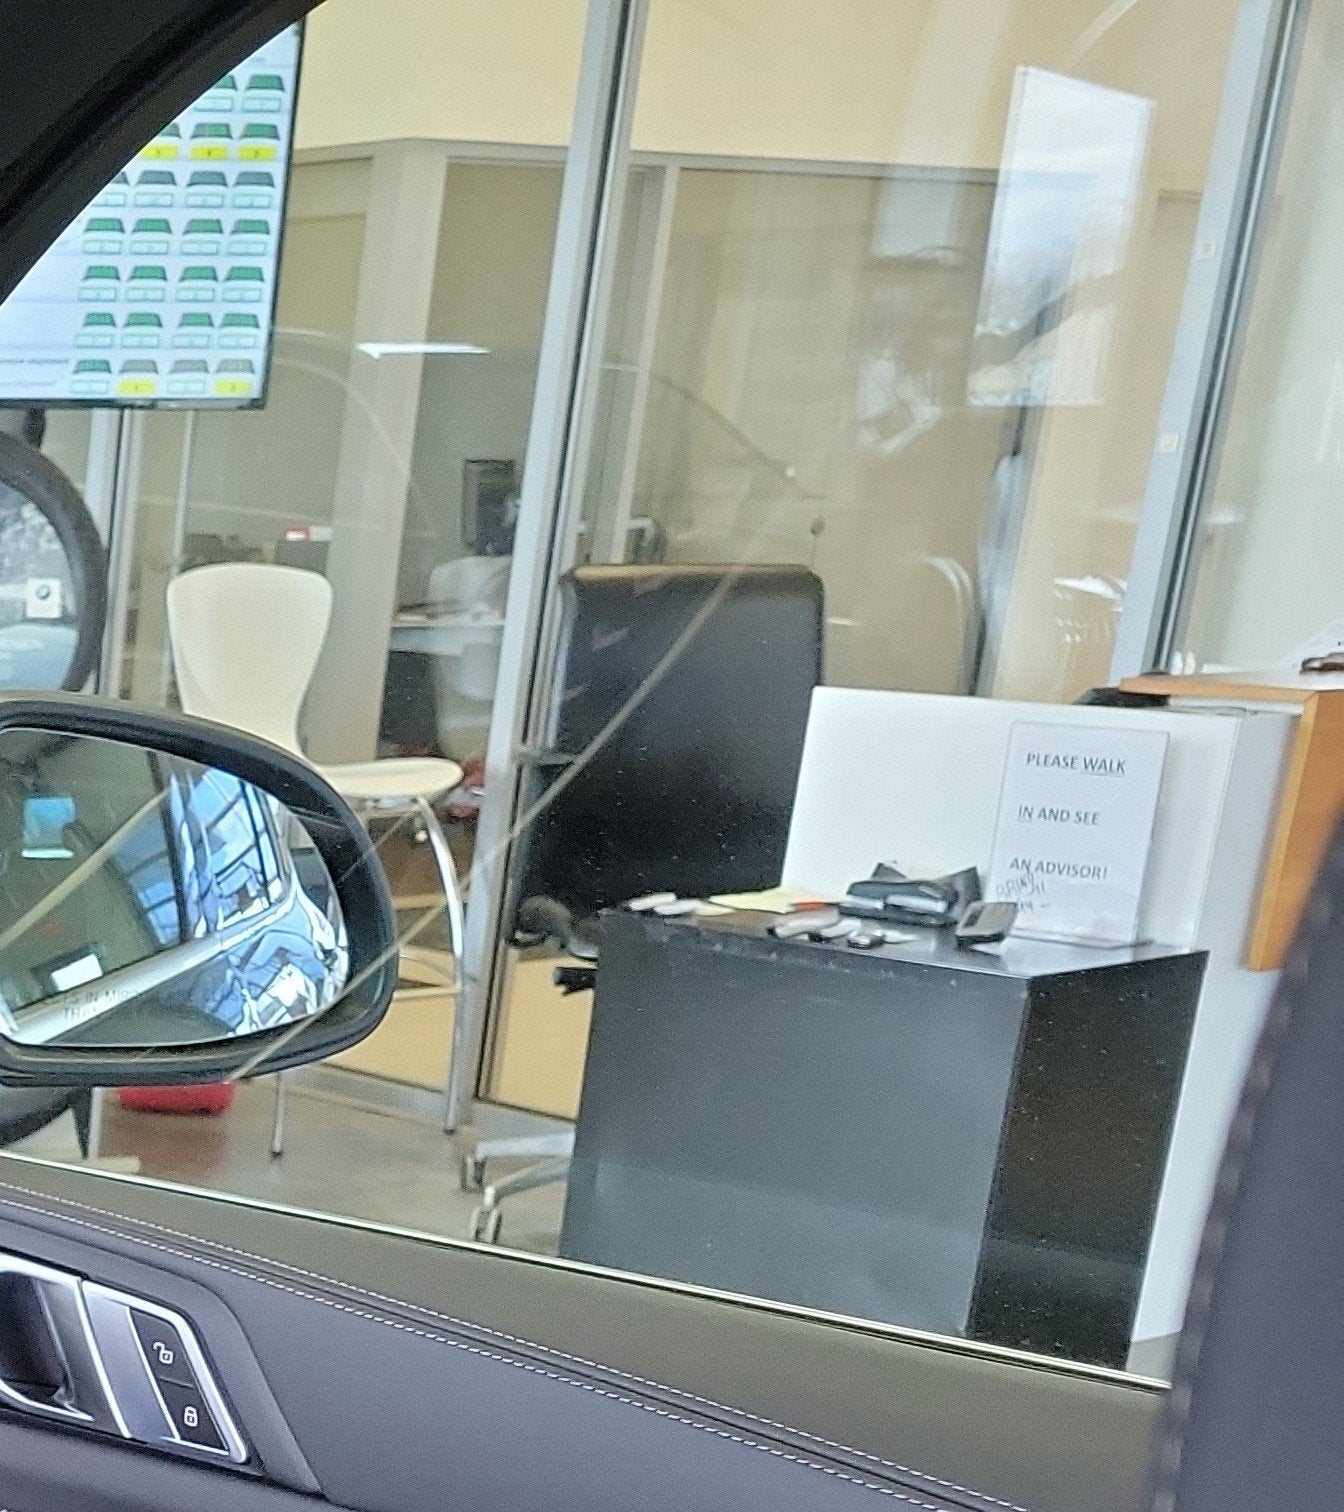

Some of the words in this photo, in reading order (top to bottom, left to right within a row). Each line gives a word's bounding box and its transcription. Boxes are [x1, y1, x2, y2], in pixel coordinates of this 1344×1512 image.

[1027, 752, 1078, 771] PLEASE
[1083, 757, 1127, 775] WALK
[1018, 805, 1034, 821] IN
[1037, 807, 1070, 823] AND
[1073, 811, 1100, 826] SEE
[1009, 857, 1031, 873] AN
[1035, 862, 1108, 881] ADVISOR!
